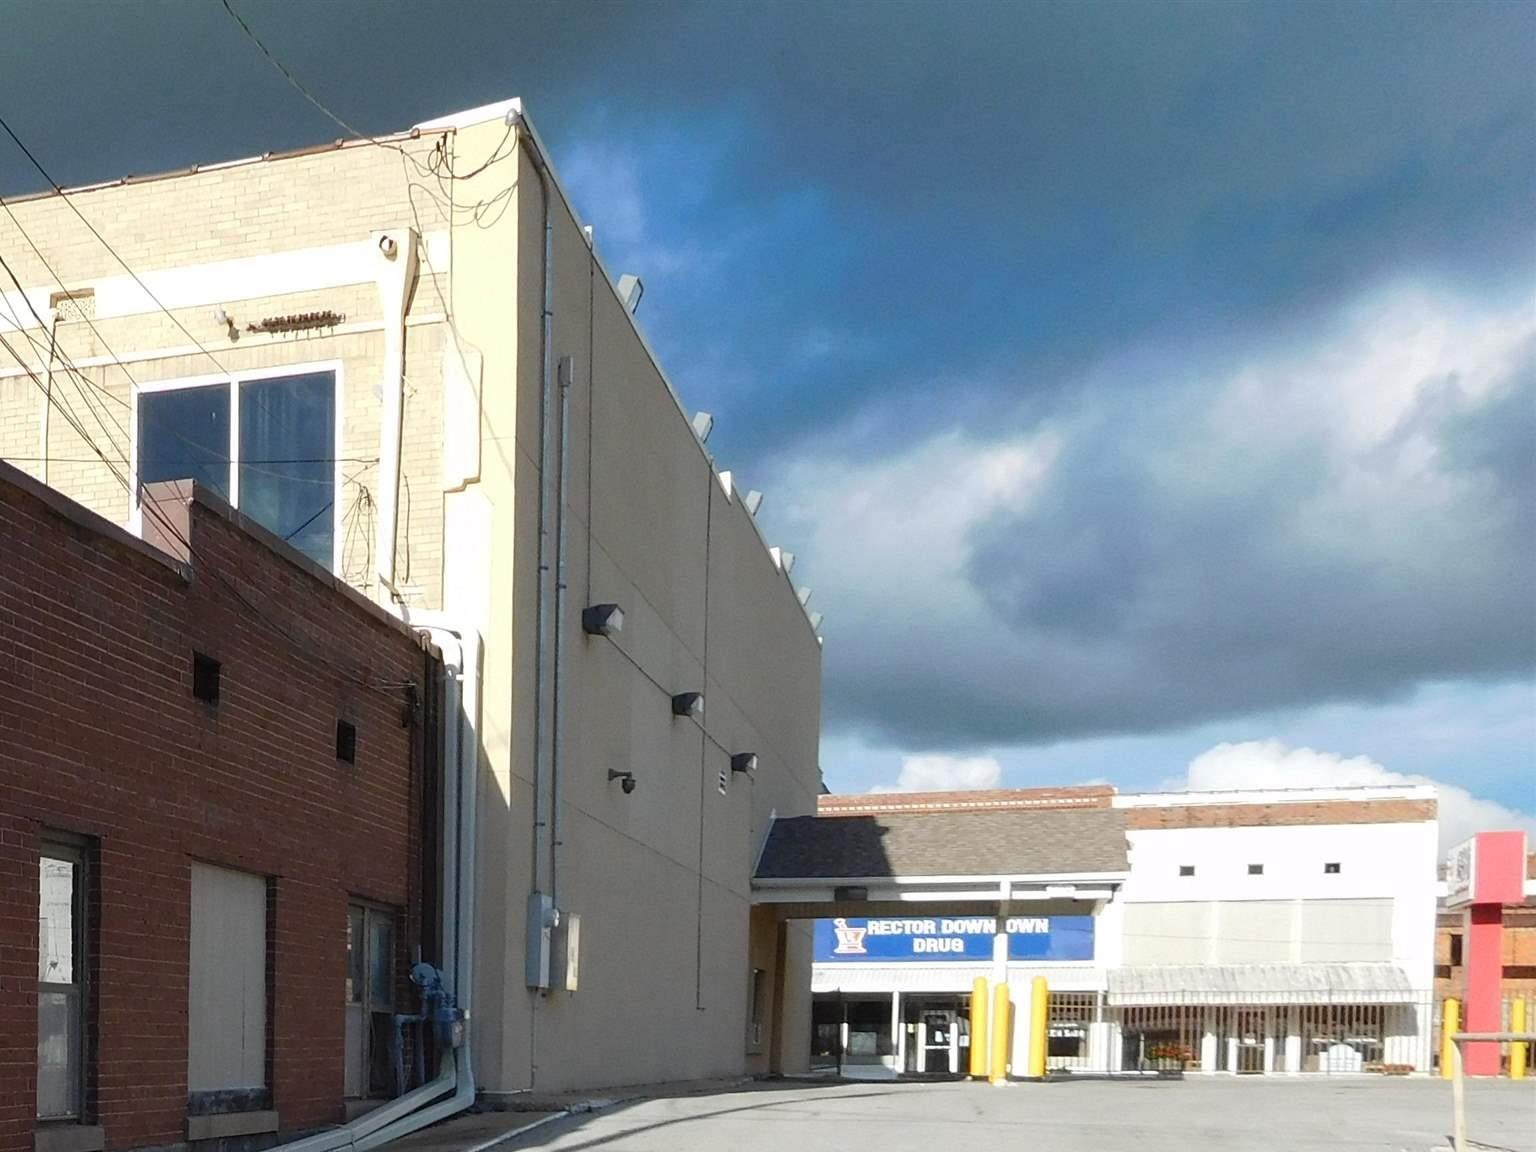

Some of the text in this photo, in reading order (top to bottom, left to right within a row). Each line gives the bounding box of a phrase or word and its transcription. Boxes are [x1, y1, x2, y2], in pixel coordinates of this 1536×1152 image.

[867, 917, 1049, 935] RECTOR DOWNOWN
[912, 938, 964, 953] DRUG
